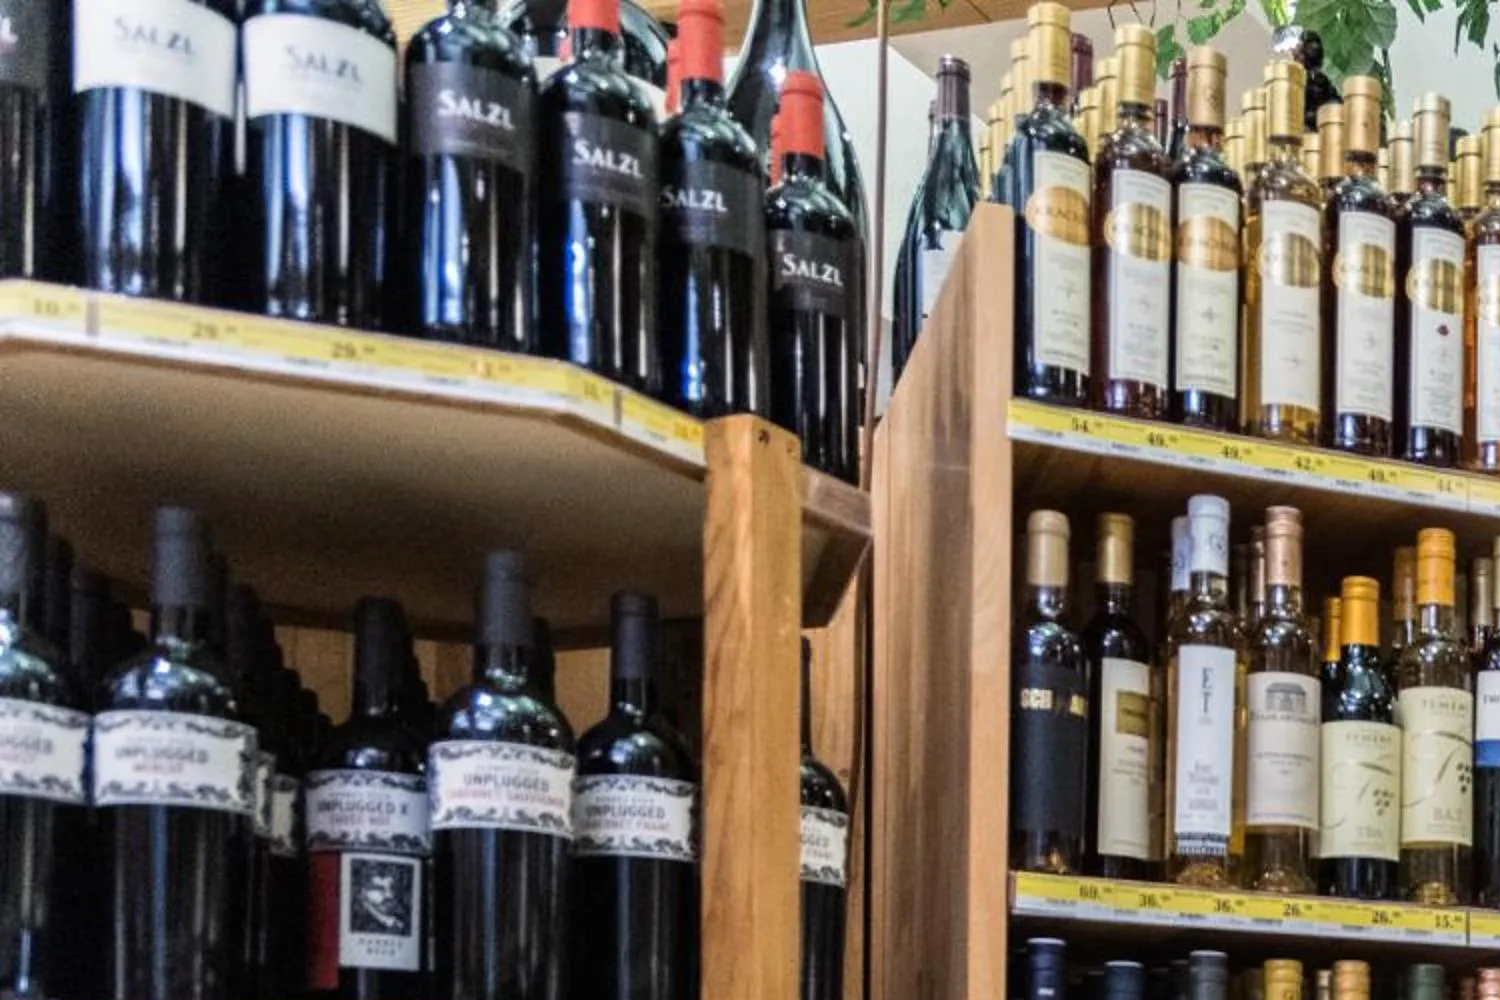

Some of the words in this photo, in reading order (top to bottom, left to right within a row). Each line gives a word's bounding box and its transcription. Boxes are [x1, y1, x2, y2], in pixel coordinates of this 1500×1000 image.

[438, 90, 514, 131] SALZL
[573, 139, 644, 179] SALZL
[782, 252, 844, 286] SALZL
[463, 773, 550, 793] UNPLUGGED
